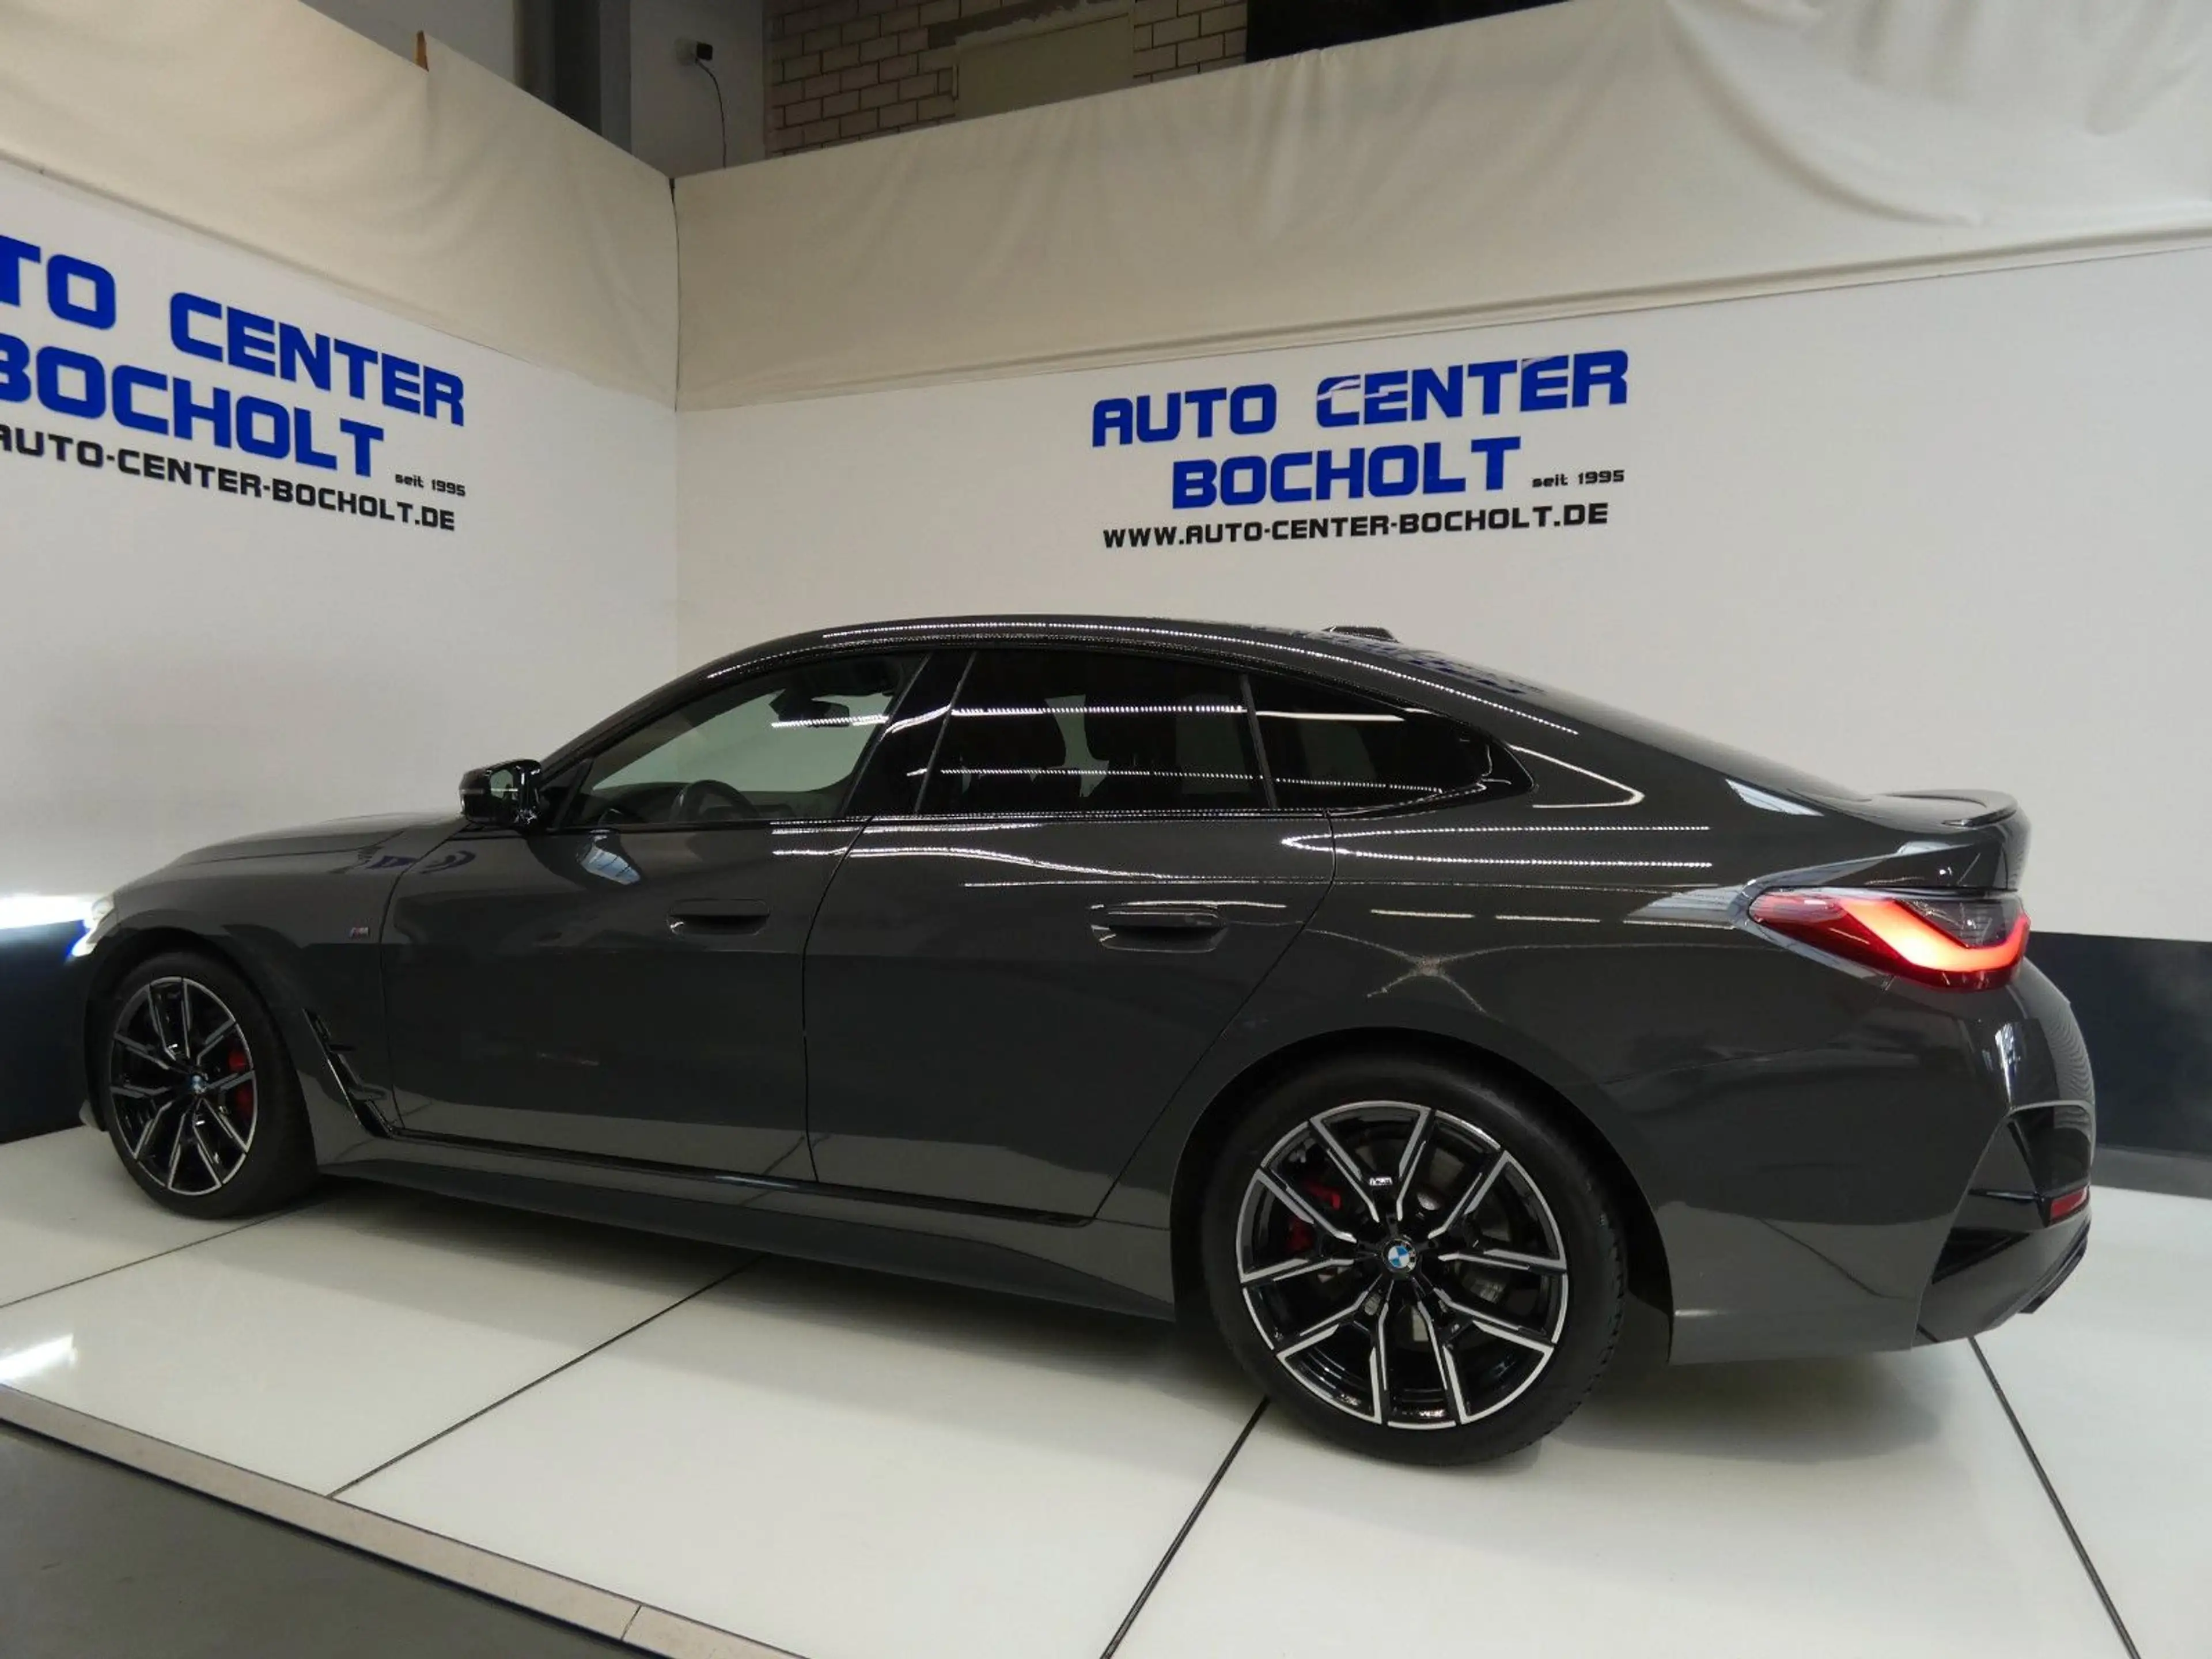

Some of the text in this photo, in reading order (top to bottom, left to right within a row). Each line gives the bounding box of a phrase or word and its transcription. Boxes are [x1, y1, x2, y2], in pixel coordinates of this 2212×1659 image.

[170, 291, 465, 427] CENTER
[1093, 349, 1630, 447] AUTO CENTER
[395, 474, 465, 497] seit 1995
[1172, 436, 1522, 510] BOCHOLT
[1532, 469, 1625, 487] seit 1995
[1103, 502, 1609, 548] WWW.AUTO-CENTER-BOCHOLT.DE
